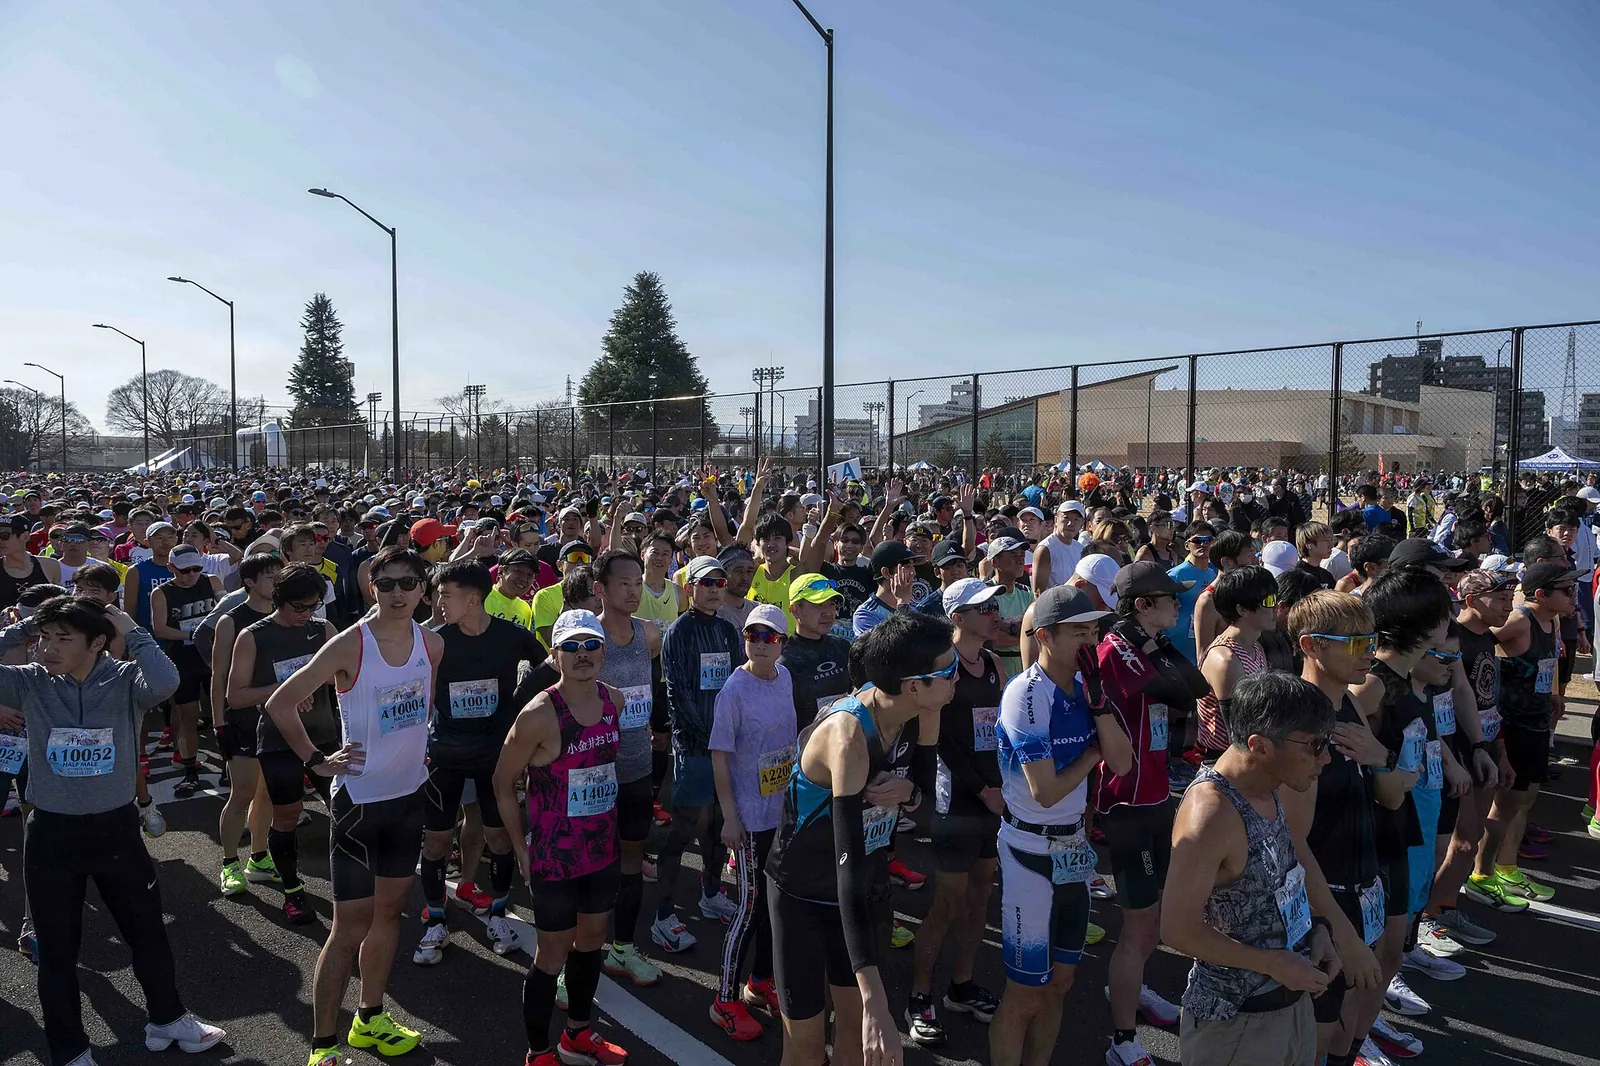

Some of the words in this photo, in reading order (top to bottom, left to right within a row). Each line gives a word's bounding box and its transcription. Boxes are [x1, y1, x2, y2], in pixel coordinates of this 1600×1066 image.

[842, 462, 856, 479] A
[814, 667, 845, 681] OAKLEY
[380, 709, 389, 720] A
[391, 696, 426, 718] 10004
[452, 700, 459, 709] A
[461, 693, 497, 708] 10019
[624, 701, 652, 716] 14010
[1026, 695, 1036, 725] KONA
[1052, 736, 1085, 745] KONA
[49, 751, 57, 762] A
[61, 747, 112, 762] 10052
[762, 774, 769, 784] A
[769, 762, 794, 782] 2200
[570, 791, 578, 802] A
[581, 782, 617, 801] 14022
[1141, 850, 1154, 876] 2XU
[1015, 906, 1023, 936] KONA
[1015, 937, 1023, 968] WINDS
